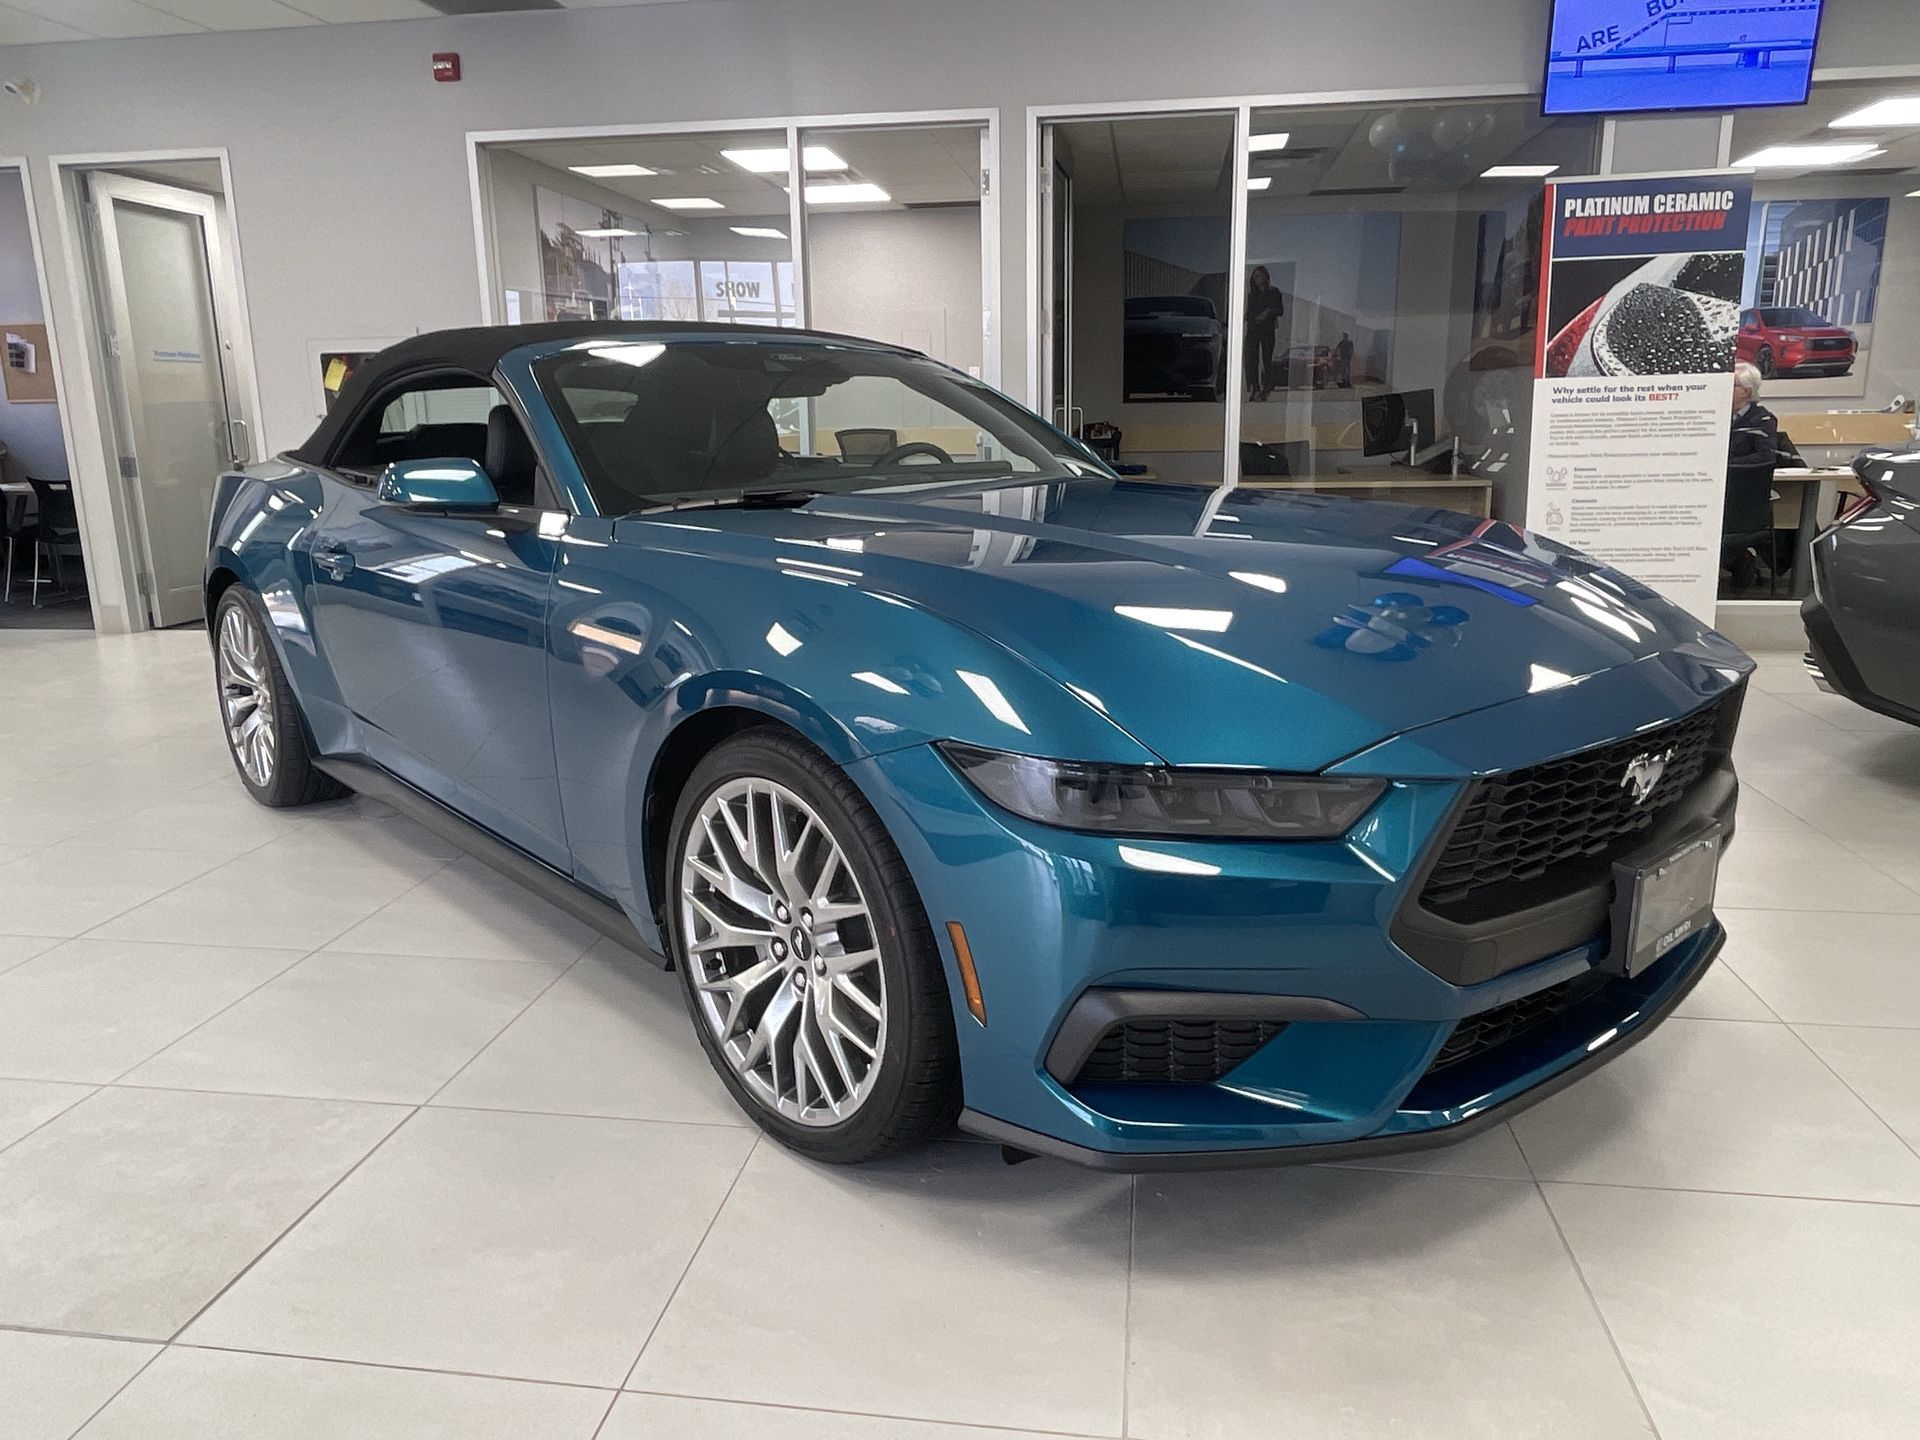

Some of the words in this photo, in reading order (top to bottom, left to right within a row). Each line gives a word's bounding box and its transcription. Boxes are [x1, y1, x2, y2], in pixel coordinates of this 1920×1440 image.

[1646, 0, 1684, 17] BU
[1576, 24, 1621, 53] ARE
[1564, 195, 1650, 218] PLATINUM
[1653, 190, 1734, 213] CERAMIC
[1563, 216, 1616, 237] PAINT
[1616, 211, 1728, 235] PROTECTION
[715, 281, 760, 298] SHOW
[1551, 395, 1584, 404] vehicle
[1585, 394, 1611, 403] could
[1612, 394, 1632, 402] look
[1634, 394, 1646, 402] its
[1648, 393, 1680, 401] BEST?
[1552, 386, 1575, 397] Why
[1576, 386, 1601, 394] settle
[1619, 385, 1635, 393] the
[1637, 385, 1655, 393] rest
[1657, 384, 1683, 392] when
[1685, 384, 1707, 393] your
